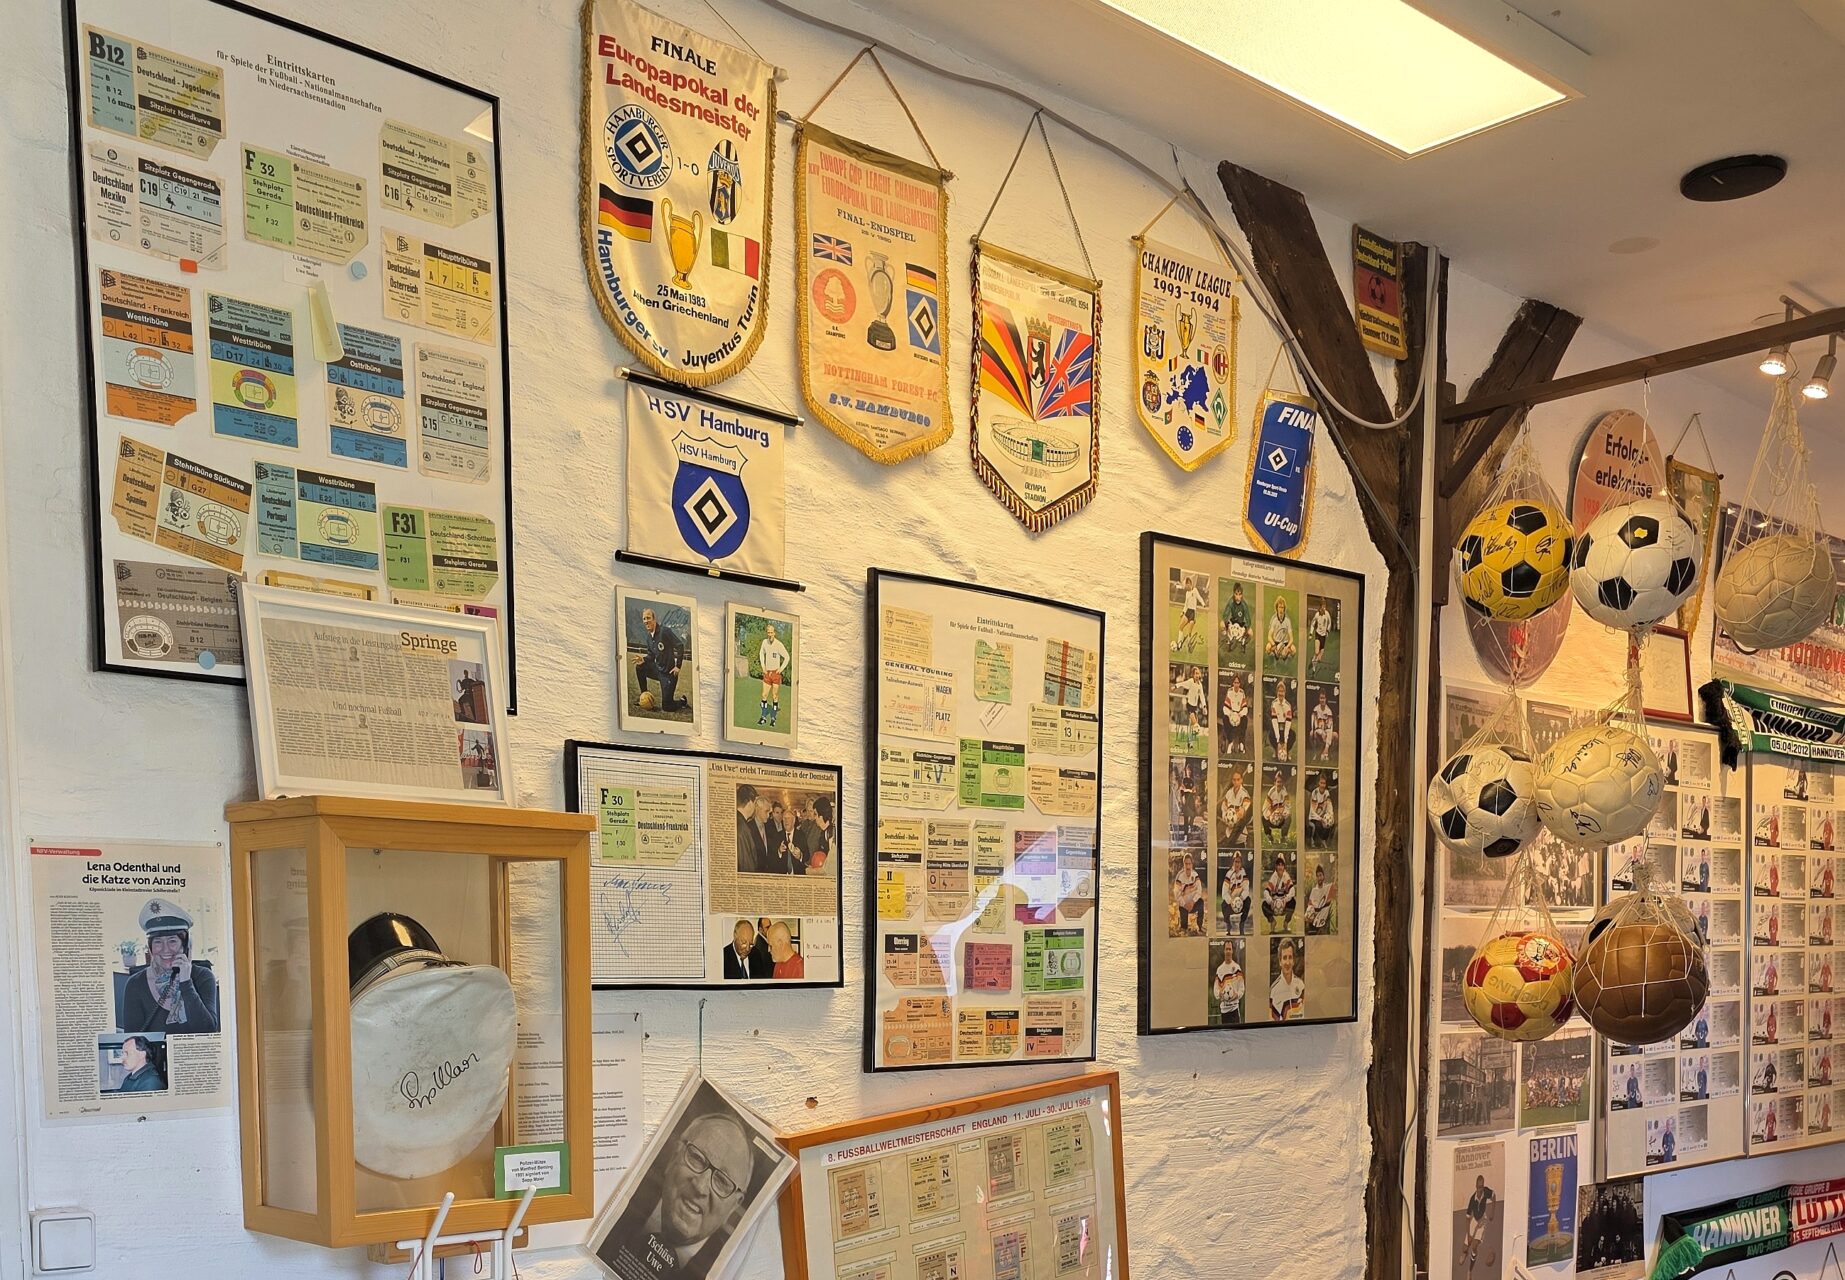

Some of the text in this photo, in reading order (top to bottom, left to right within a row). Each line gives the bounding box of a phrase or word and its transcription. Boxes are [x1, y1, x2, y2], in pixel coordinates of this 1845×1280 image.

[88, 31, 124, 66] B12
[651, 36, 716, 76] FINALE
[137, 66, 176, 85] Deutschland
[217, 50, 228, 61] für
[231, 55, 253, 70] Spiele
[255, 64, 267, 74] der
[269, 68, 298, 84] Fußball
[305, 80, 382, 113] Nationalmannschaften
[267, 54, 336, 86] Eintrittskarten
[598, 34, 760, 121] Europapokal der
[258, 74, 346, 111] im Niedersachsenstadion
[606, 63, 751, 141] Landesmeister
[150, 101, 176, 115] Sitzplatz
[607, 107, 668, 150] HAMBURGER
[606, 145, 670, 187] SPORTVEREIN
[710, 150, 740, 182] JUVENTUS
[93, 171, 133, 193] Deutschland
[253, 179, 284, 192] Stehplatz
[385, 184, 399, 201] C16
[822, 176, 868, 211] EUROPAPOKAL
[101, 187, 126, 204] Mexiko
[257, 188, 281, 200] Gerade
[895, 179, 937, 210] CHAMPIONS
[387, 261, 420, 279] Deutschland
[438, 250, 478, 268] Haupttribüne
[597, 229, 651, 340] Hamburger
[1141, 251, 1232, 298] CHAMPION LEAGUE
[103, 294, 146, 310] Deutschland
[657, 284, 706, 308] 25 Mai 1983
[1153, 278, 1220, 313] 1993-1994
[126, 312, 168, 327] Westtribüne
[663, 300, 729, 329] Griechenland
[682, 285, 758, 373] Juventus Turin
[232, 335, 272, 350] Westtribüne
[350, 361, 381, 374] Osttribüne
[422, 371, 485, 392] Deutschland England
[824, 363, 924, 397] NOTTINGHAM FOREST
[649, 395, 769, 448] HSV Hamburg
[679, 442, 737, 470] HSV Hamburg
[174, 458, 245, 491] Stehtribüne Südkurve
[319, 476, 355, 489] Westtribüne
[392, 512, 416, 535] F31
[1264, 512, 1298, 536] UI-Cup
[977, 616, 1014, 629] Eintrittskarten
[314, 632, 360, 646] Aufstieg die
[401, 632, 457, 655] Springe
[885, 661, 953, 677] GENERAL TOURING
[333, 701, 402, 716] Und nochmal Fußball
[935, 712, 951, 722] PLATZ
[1771, 700, 1843, 725] EUROPA LEAGUE
[1771, 739, 1809, 756] 05.04.2012
[739, 766, 835, 781] erlebt Domstadt
[87, 861, 181, 873] Lena Odenthal und
[82, 874, 186, 887] die Katze von Anzing
[837, 1097, 1091, 1162] FUSSBALLWELTMEISTERSCHAFT ENGLAND 11. JULI 30. JULI 1966
[1455, 1152, 1490, 1164] Hannover
[1530, 1134, 1577, 1162] BERLIN
[1693, 1205, 1781, 1253] HANNOVER
[1802, 1226, 1830, 1241] SEPTEMBER
[646, 1251, 662, 1271] Uwe
[648, 1234, 674, 1268] Tschüss,
